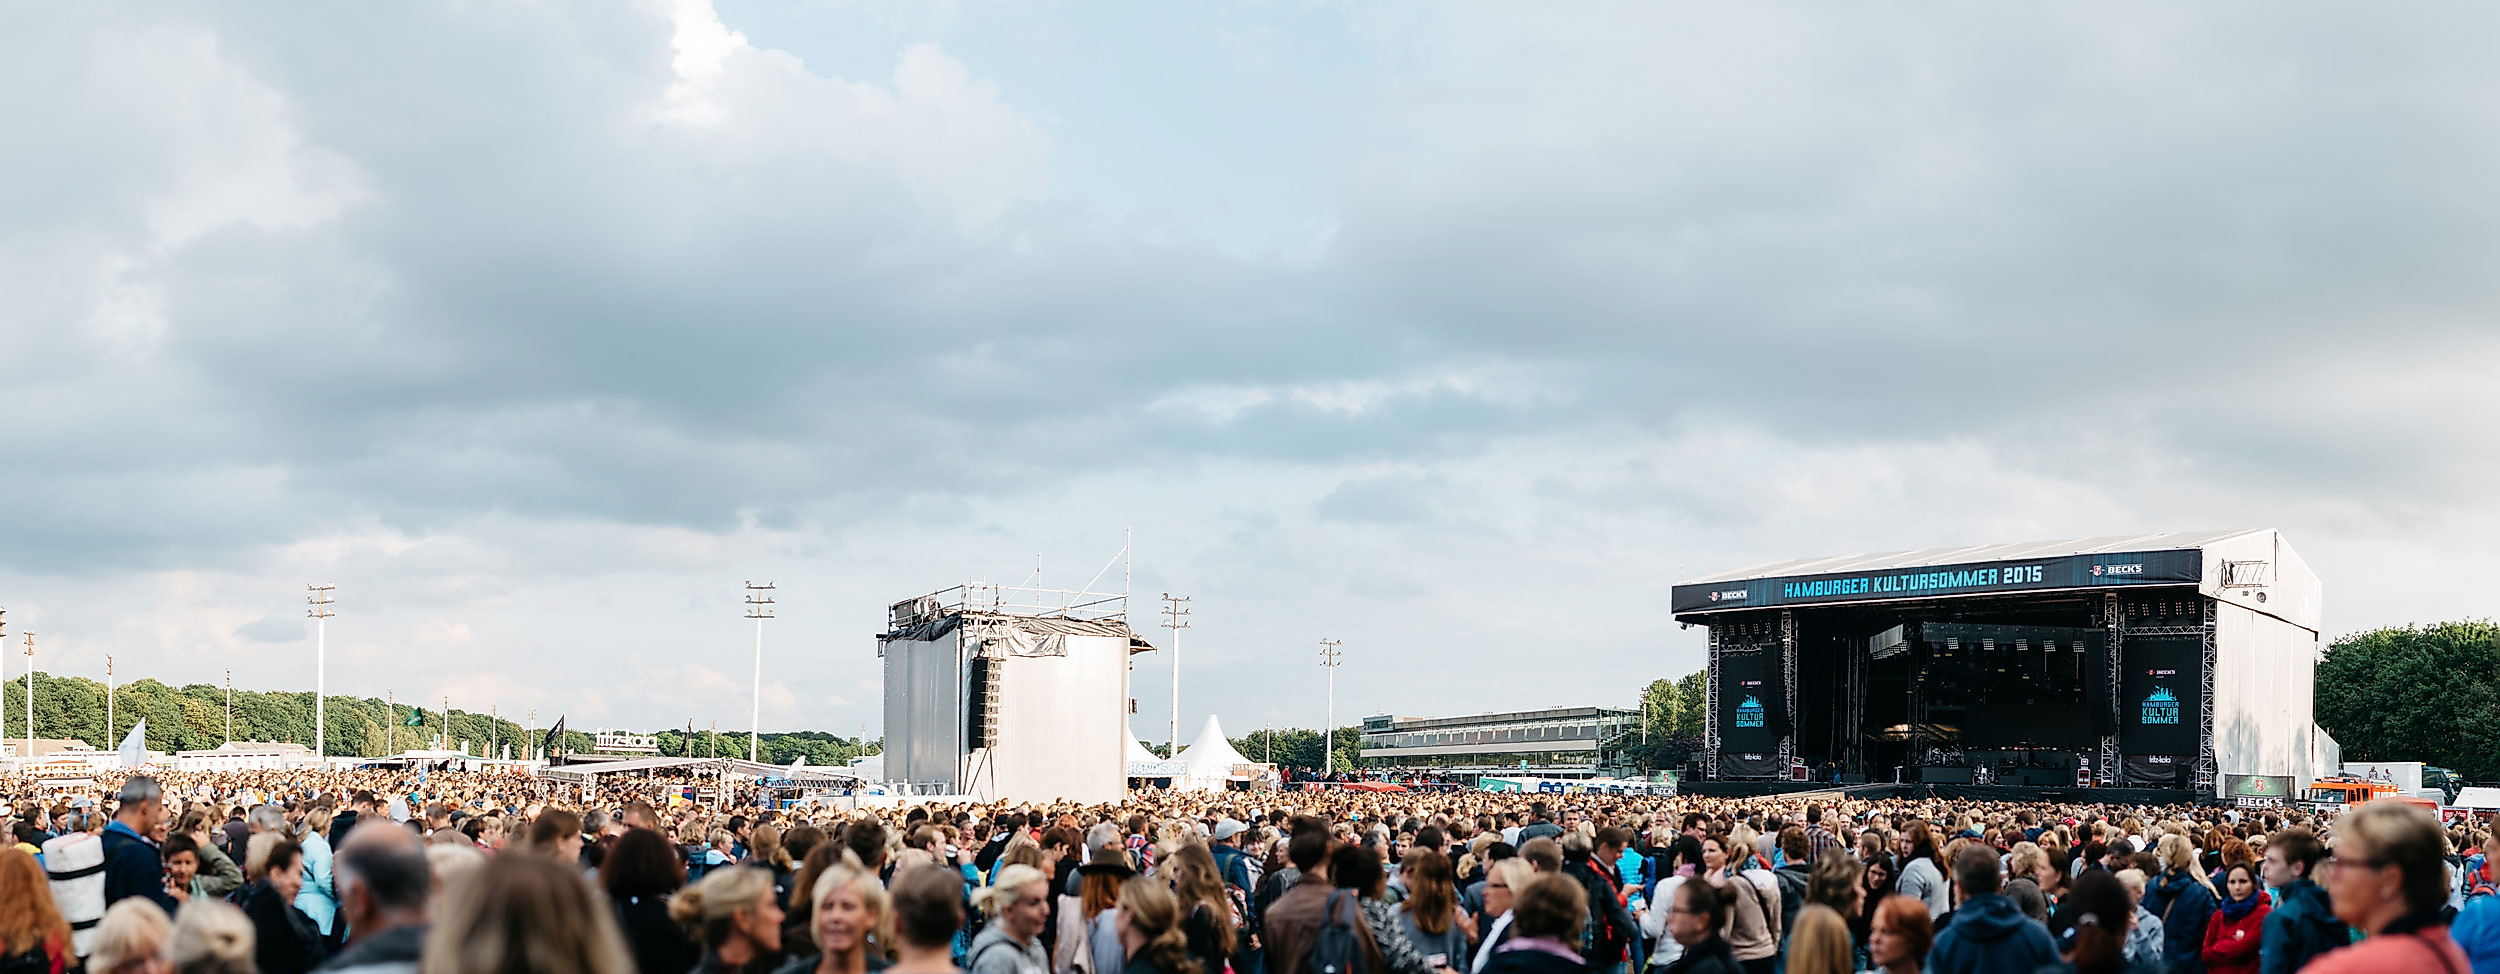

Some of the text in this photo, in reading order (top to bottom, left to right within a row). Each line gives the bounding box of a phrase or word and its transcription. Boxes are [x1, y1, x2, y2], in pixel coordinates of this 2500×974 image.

[2107, 564, 2143, 575] BECK'S
[1784, 565, 2043, 598] HAMBURGER KULTURSOMMER 2015
[1736, 712, 1764, 721] KULTUR
[2142, 708, 2179, 716] KULTUR
[1736, 720, 1764, 728] SOMMER
[2237, 796, 2284, 808] BECK'S
